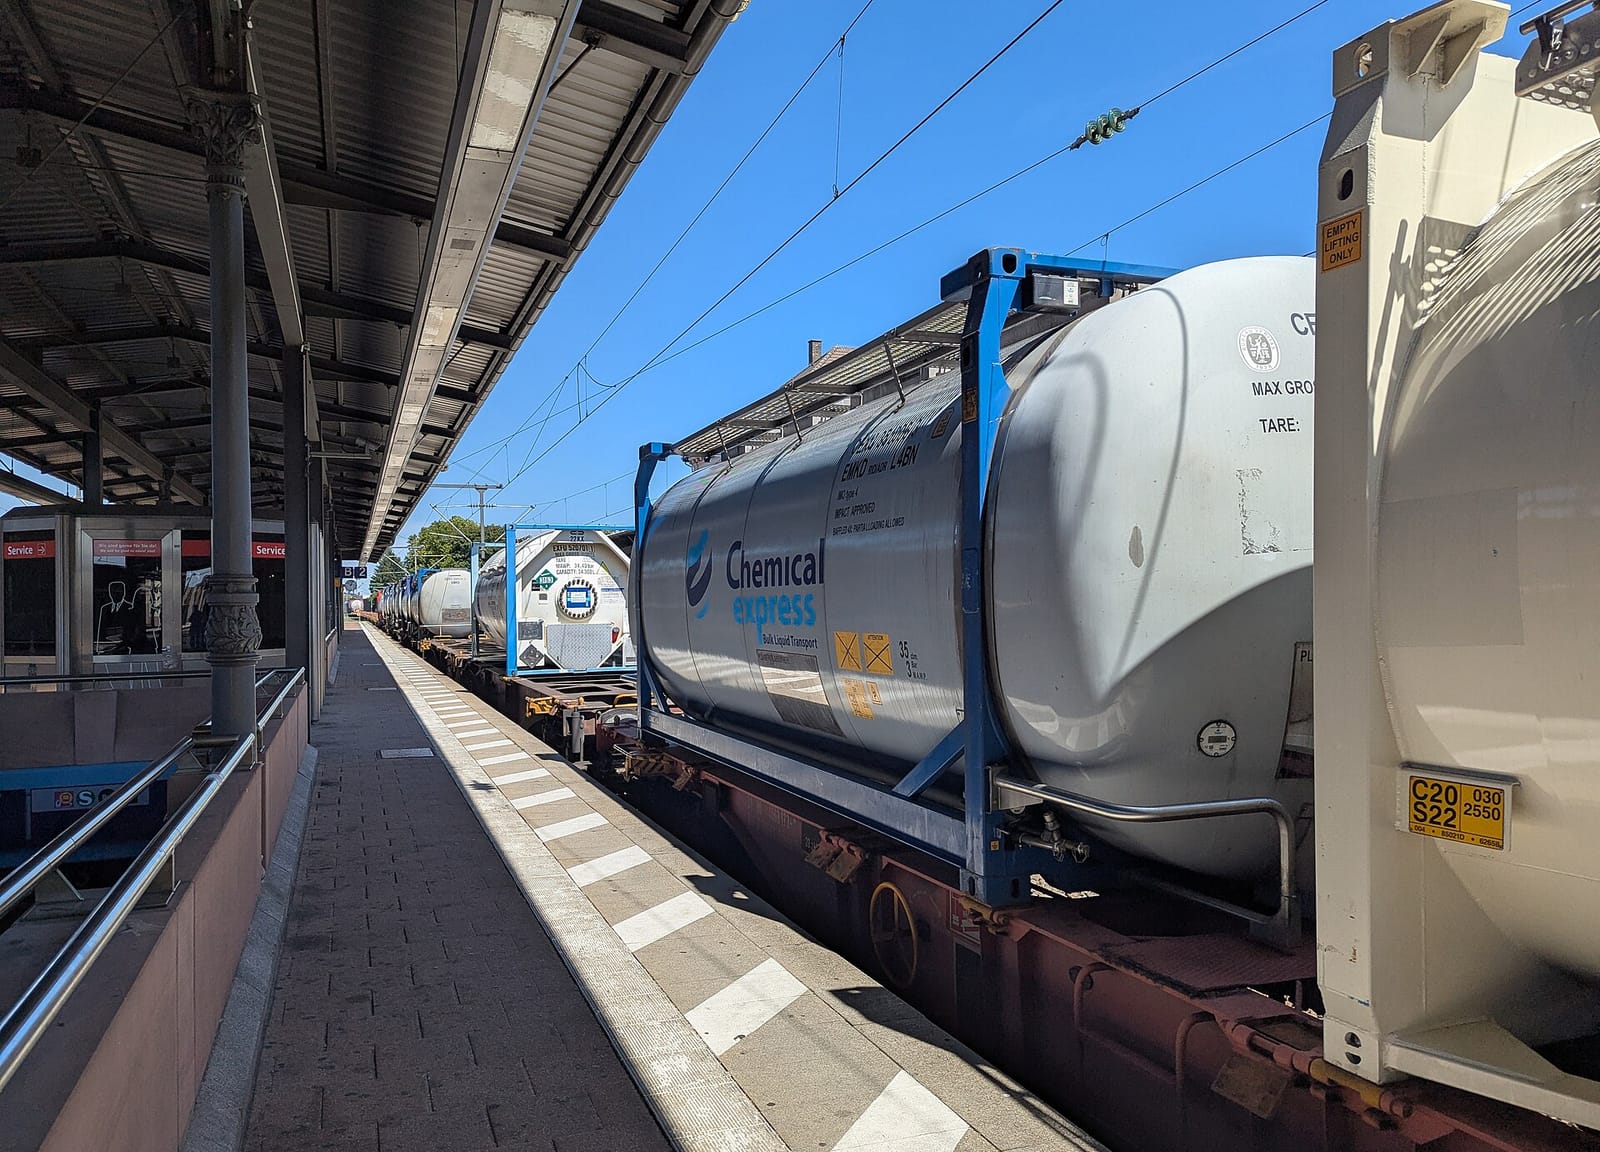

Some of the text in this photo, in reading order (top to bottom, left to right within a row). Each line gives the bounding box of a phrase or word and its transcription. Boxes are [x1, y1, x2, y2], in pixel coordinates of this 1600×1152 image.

[1327, 219, 1357, 238] EMPTY
[1325, 232, 1359, 252] LIFTING
[1330, 247, 1353, 263] ONLY
[1251, 380, 1316, 396] MAX GRO
[1259, 417, 1301, 433] TARE:
[7, 545, 34, 556] Service
[256, 545, 286, 555] Service
[344, 568, 352, 576] B
[360, 568, 366, 576] 2
[727, 538, 825, 590] Chemical
[733, 593, 817, 646] express
[774, 635, 790, 648] Liquid
[790, 635, 818, 650] Transport
[899, 641, 909, 659] 35
[905, 661, 912, 678] 3
[1412, 779, 1502, 806] C20 030
[1413, 801, 1501, 828] S22 2550
